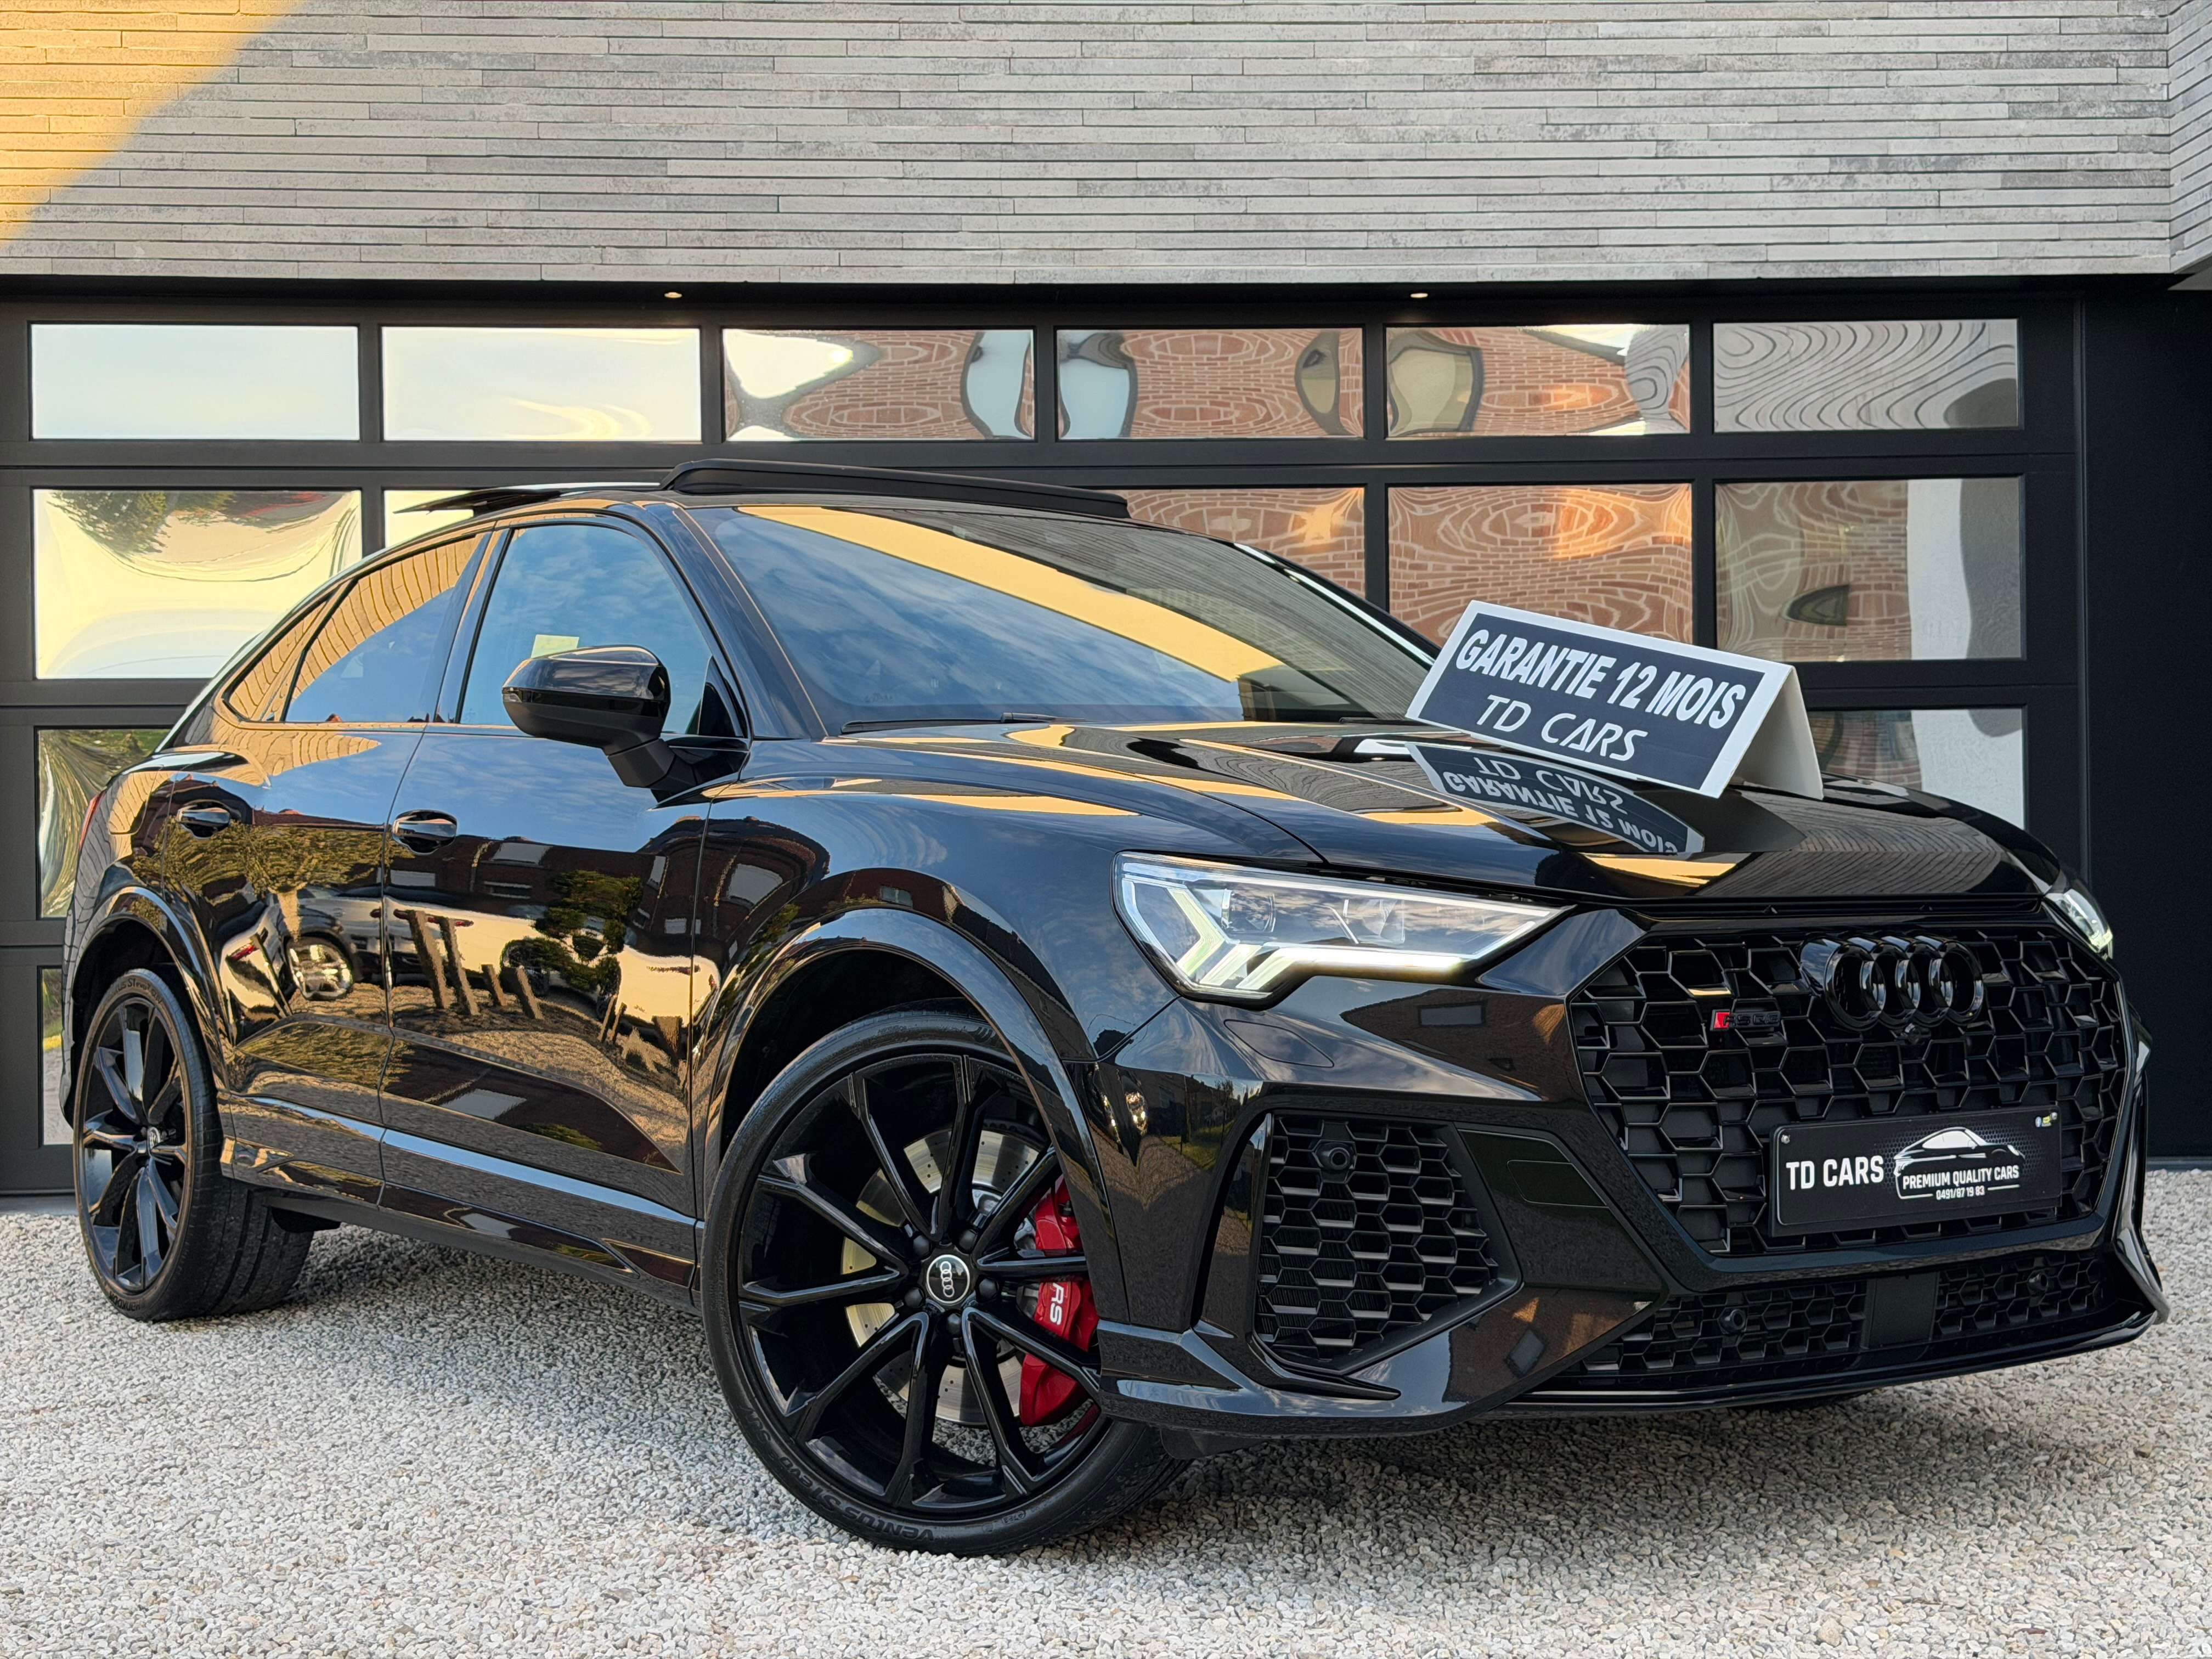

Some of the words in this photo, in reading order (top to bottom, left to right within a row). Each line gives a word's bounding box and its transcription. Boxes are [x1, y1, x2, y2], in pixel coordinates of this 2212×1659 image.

[1456, 629, 1617, 699] GARANTIE
[1607, 662, 1657, 709] 12
[1645, 671, 1746, 729] MOIS
[1476, 694, 1532, 732] TD
[1541, 713, 1649, 761] CARS
[1786, 1160, 1815, 1190] TD
[1823, 1155, 1884, 1187] CARS
[1903, 1172, 1950, 1190] PREMIUM
[1953, 1167, 1993, 1186] QUALITY
[1994, 1165, 2019, 1180] CARS
[1936, 1188, 1965, 1200] 0491/87
[1966, 1187, 1974, 1196] 19
[1975, 1185, 1985, 1195] 83
[1050, 1283, 1064, 1325] RS
